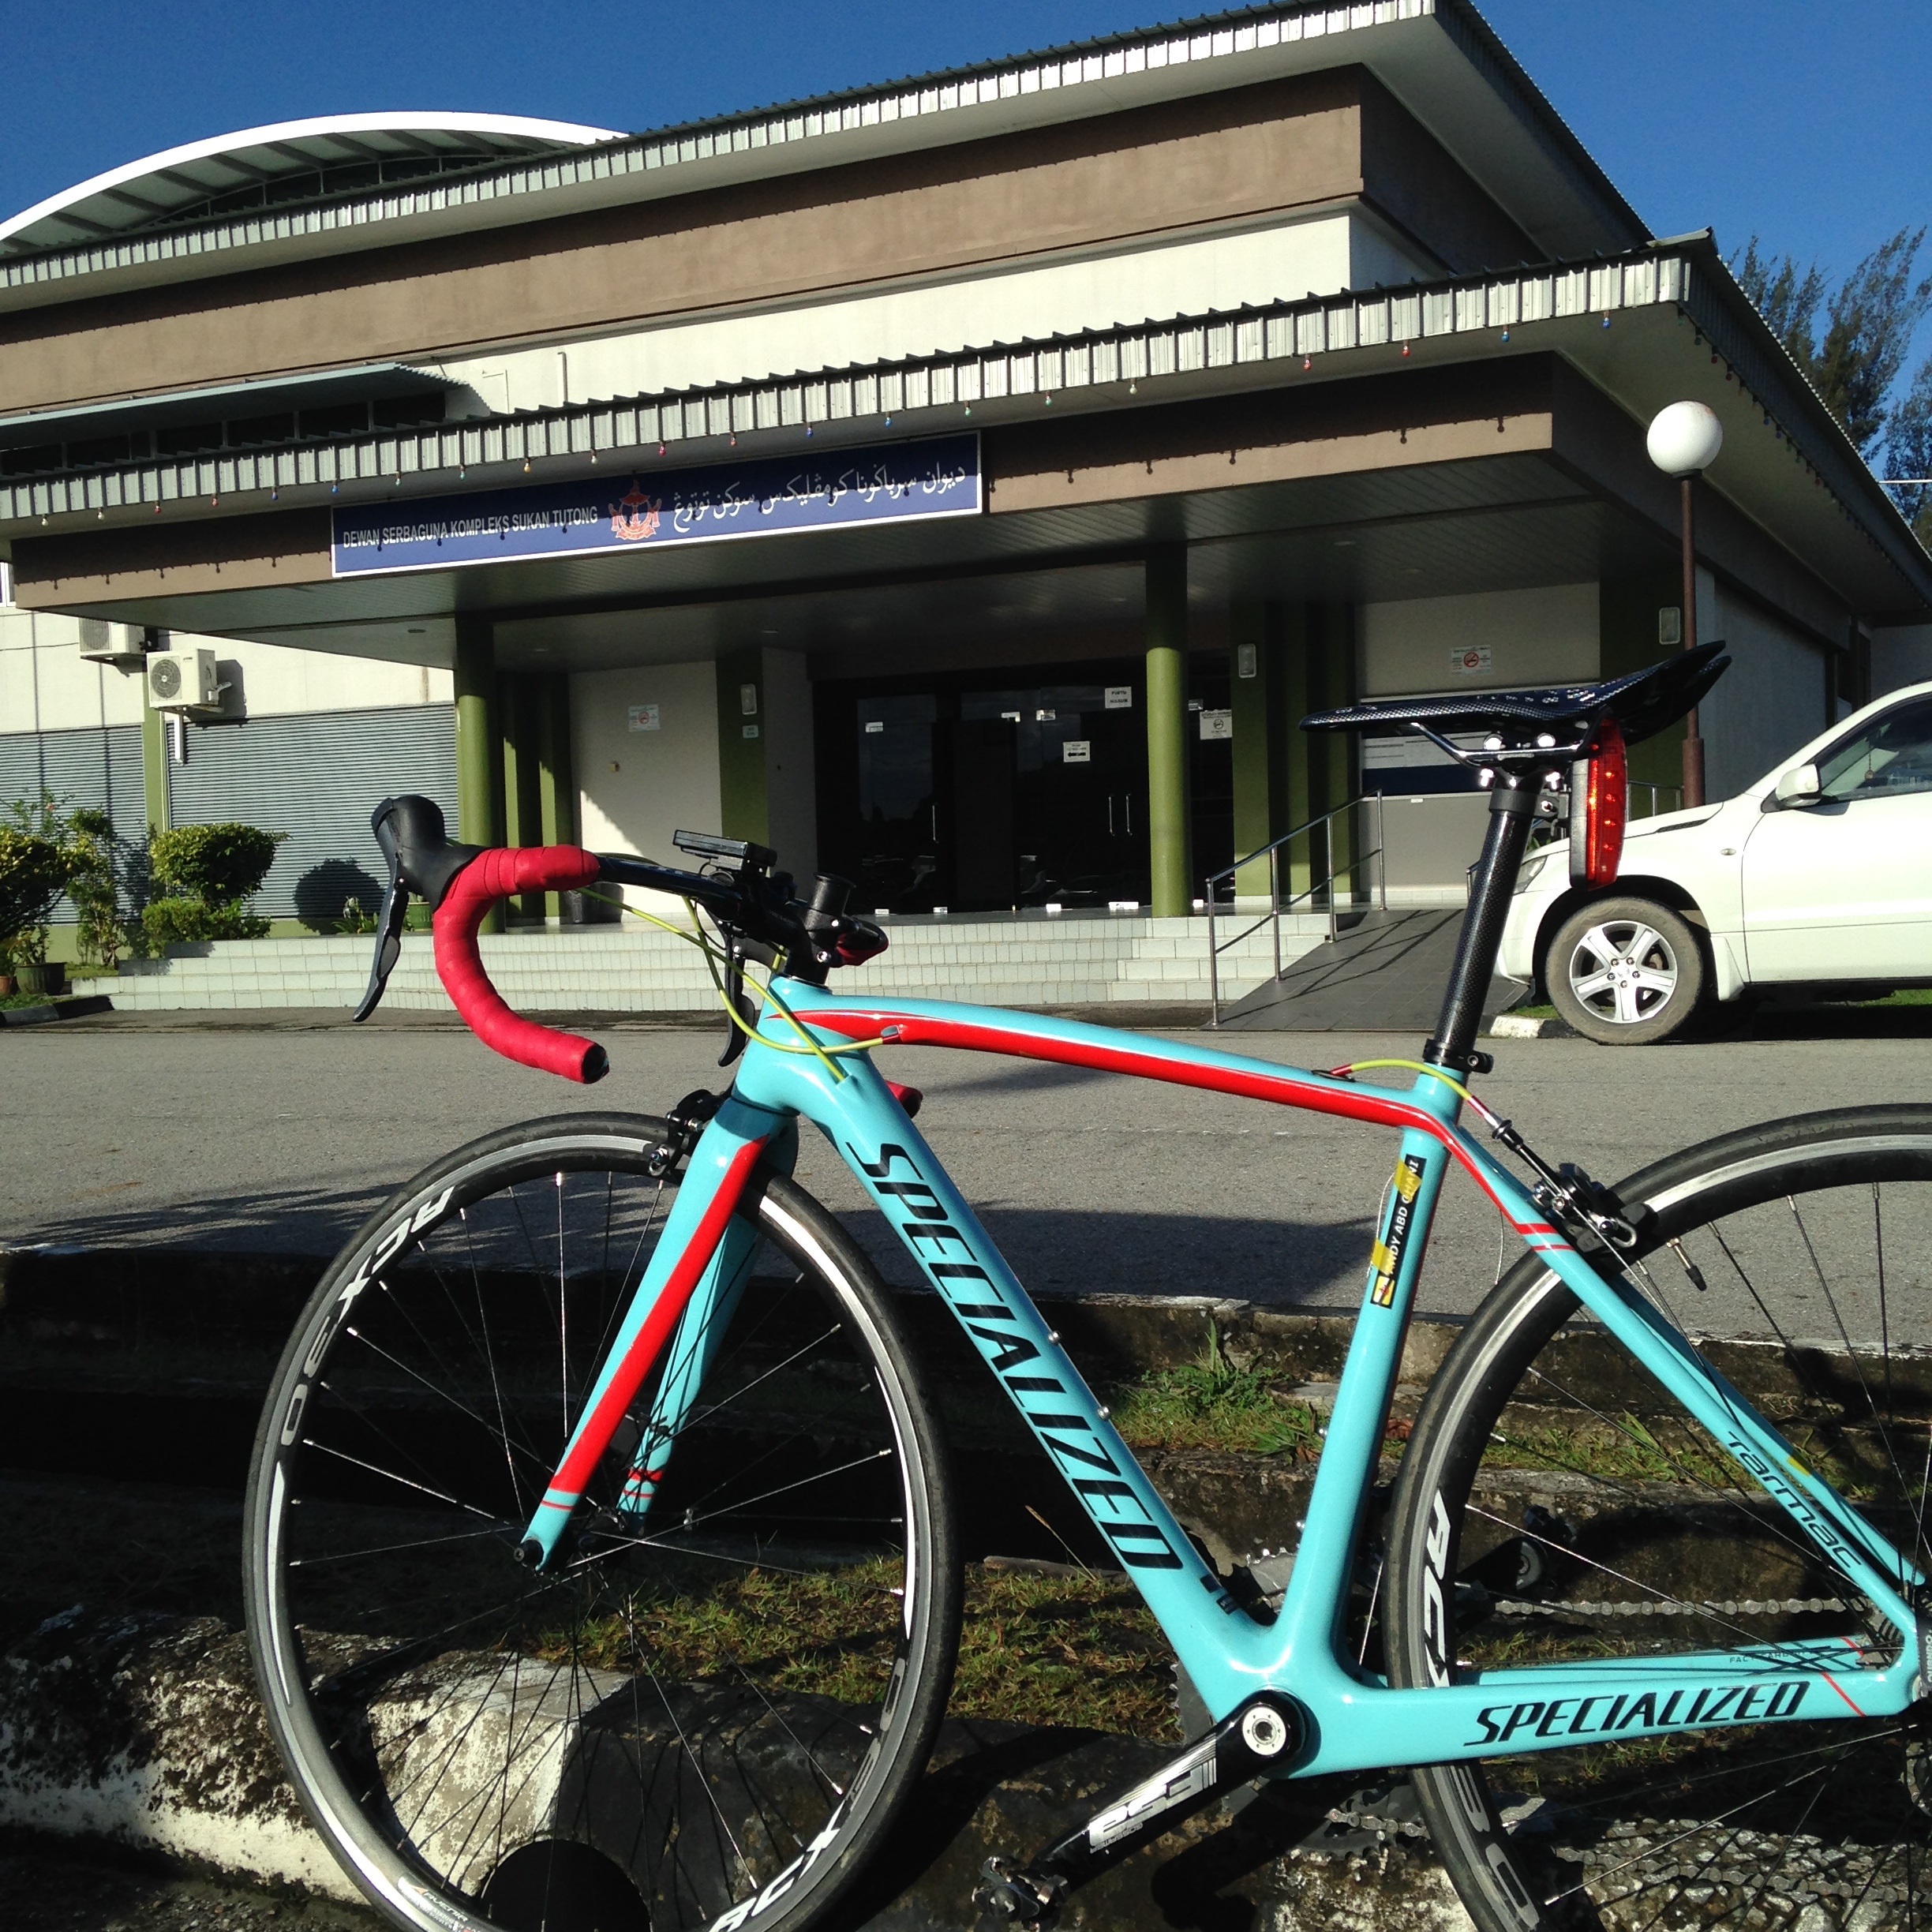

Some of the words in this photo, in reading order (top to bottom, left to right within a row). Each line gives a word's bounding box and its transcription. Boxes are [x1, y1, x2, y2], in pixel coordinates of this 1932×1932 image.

[343, 528, 380, 549] DEWAN
[382, 522, 449, 545] SERBAGUNA
[451, 515, 510, 537] KOMPLEKS
[511, 510, 550, 531] SUKAN
[552, 505, 598, 527] TUTONG
[1395, 1207, 1408, 1236] ABD
[845, 1141, 1184, 1571] SPECIALIZED
[1462, 1680, 1811, 1747] SPECIALIZED
